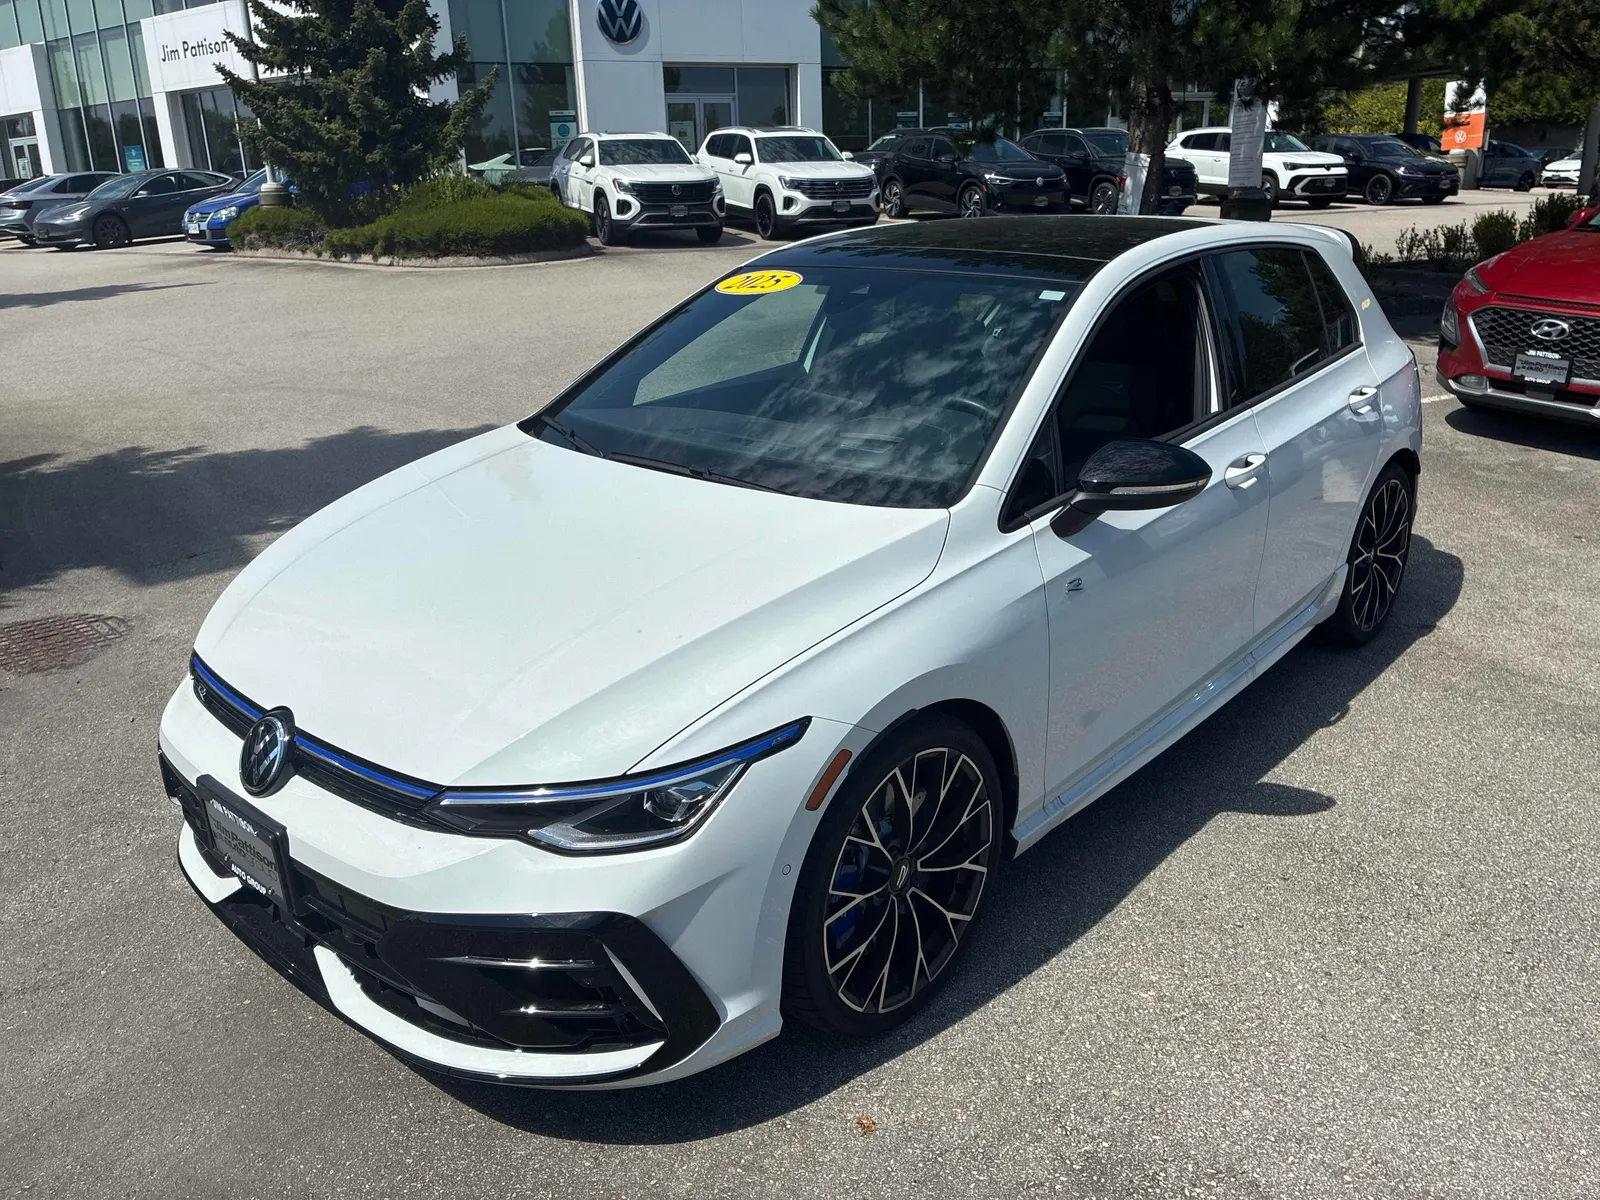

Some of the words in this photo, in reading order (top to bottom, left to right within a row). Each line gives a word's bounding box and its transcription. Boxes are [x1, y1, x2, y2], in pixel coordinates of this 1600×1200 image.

[161, 44, 180, 62] Jim
[182, 38, 229, 59] Pattison
[721, 274, 793, 290] 2025
[1536, 350, 1561, 359] PATTISON
[211, 798, 224, 814] JIM
[222, 805, 256, 836] PATTISON
[231, 863, 246, 880] AUTO
[246, 875, 267, 895] GROUP
